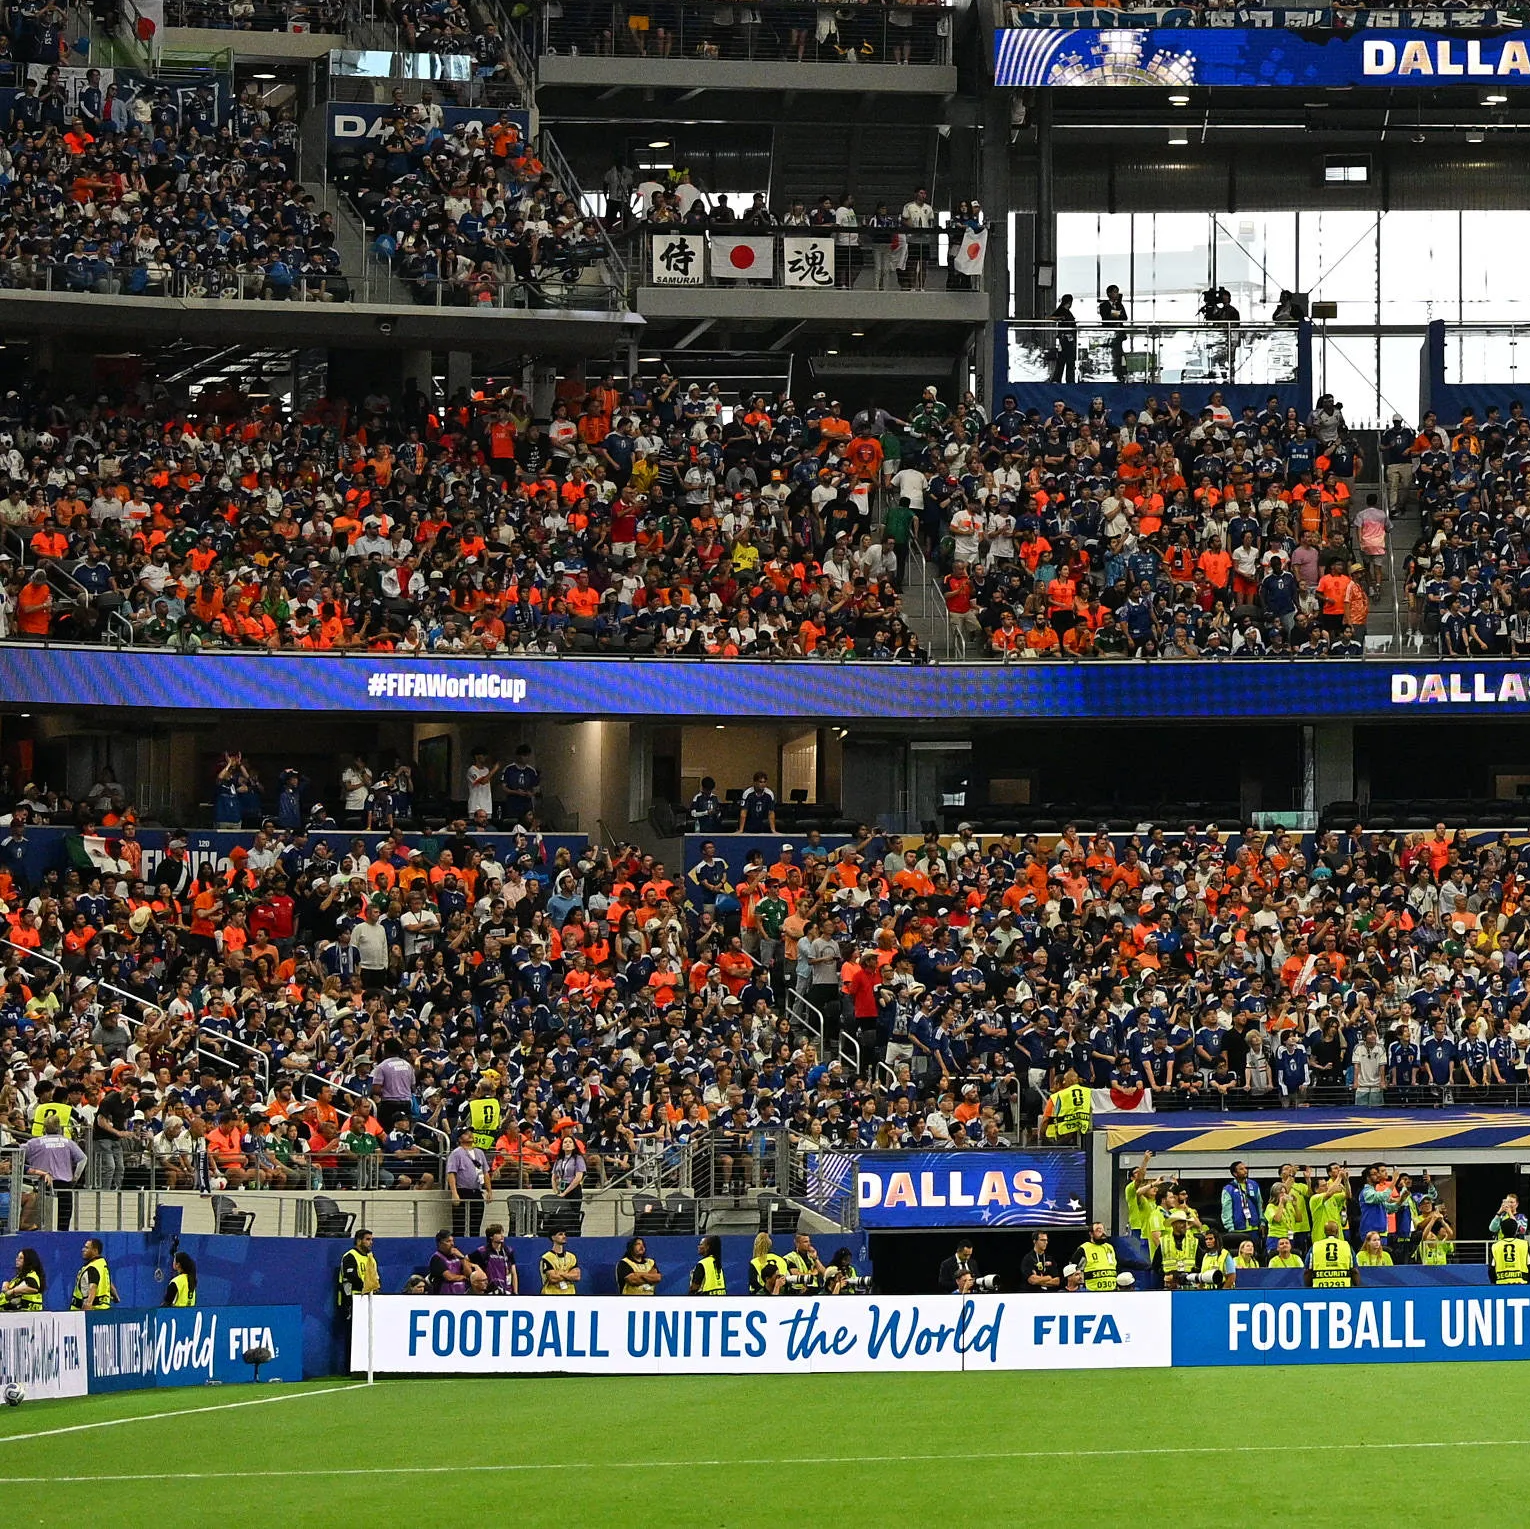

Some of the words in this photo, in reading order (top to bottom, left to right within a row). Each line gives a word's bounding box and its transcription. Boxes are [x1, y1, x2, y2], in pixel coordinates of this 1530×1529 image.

[659, 236, 696, 276] 侍
[787, 249, 834, 286] 魂
[656, 275, 701, 284] SAMURAI
[367, 671, 527, 703] #FIFAWorldCup
[198, 839, 210, 847] 120
[857, 1168, 1043, 1208] DALLAS
[92, 1323, 119, 1377] FOOTBALL
[120, 1322, 141, 1375] UNITES
[153, 1311, 218, 1378] World
[229, 1326, 276, 1361] FIFA
[408, 1309, 609, 1358] FOOTBALL
[626, 1310, 766, 1357] UNITES
[780, 1302, 858, 1362] the
[867, 1300, 1007, 1362] World
[1034, 1314, 1122, 1346] FIFA
[1228, 1300, 1425, 1351] FOOTBALL
[63, 1335, 80, 1371] FIFA
